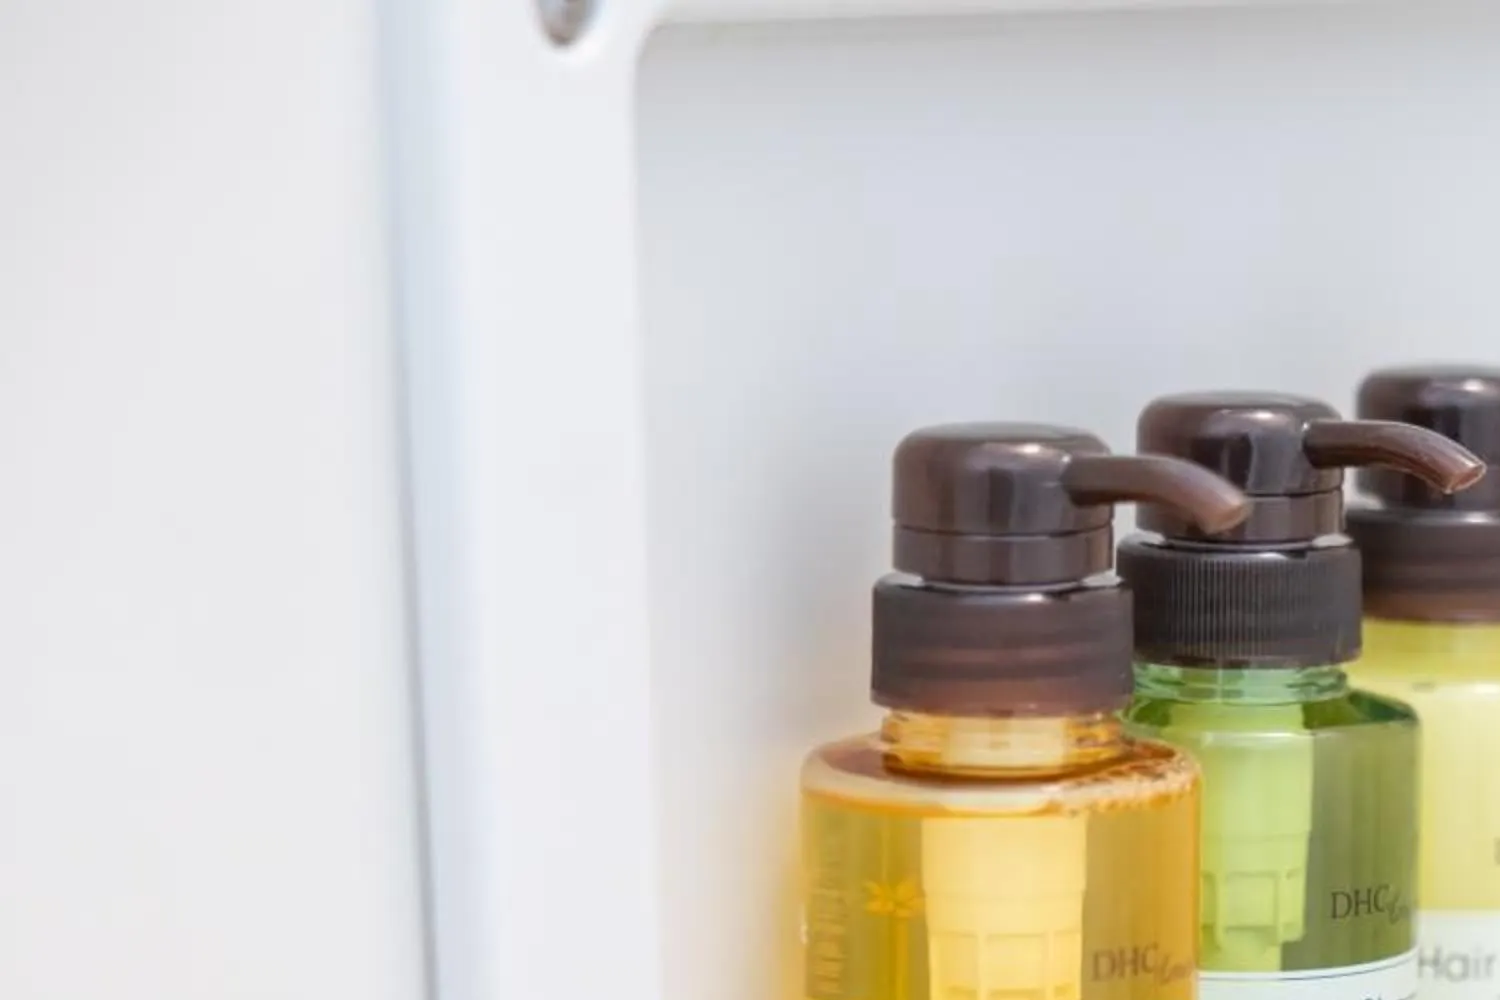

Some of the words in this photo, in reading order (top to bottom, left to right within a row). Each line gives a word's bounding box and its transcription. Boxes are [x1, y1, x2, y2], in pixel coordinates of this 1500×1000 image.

[1331, 883, 1390, 920] DHC
[1091, 942, 1159, 983] DHC
[1417, 943, 1495, 983] Hair
